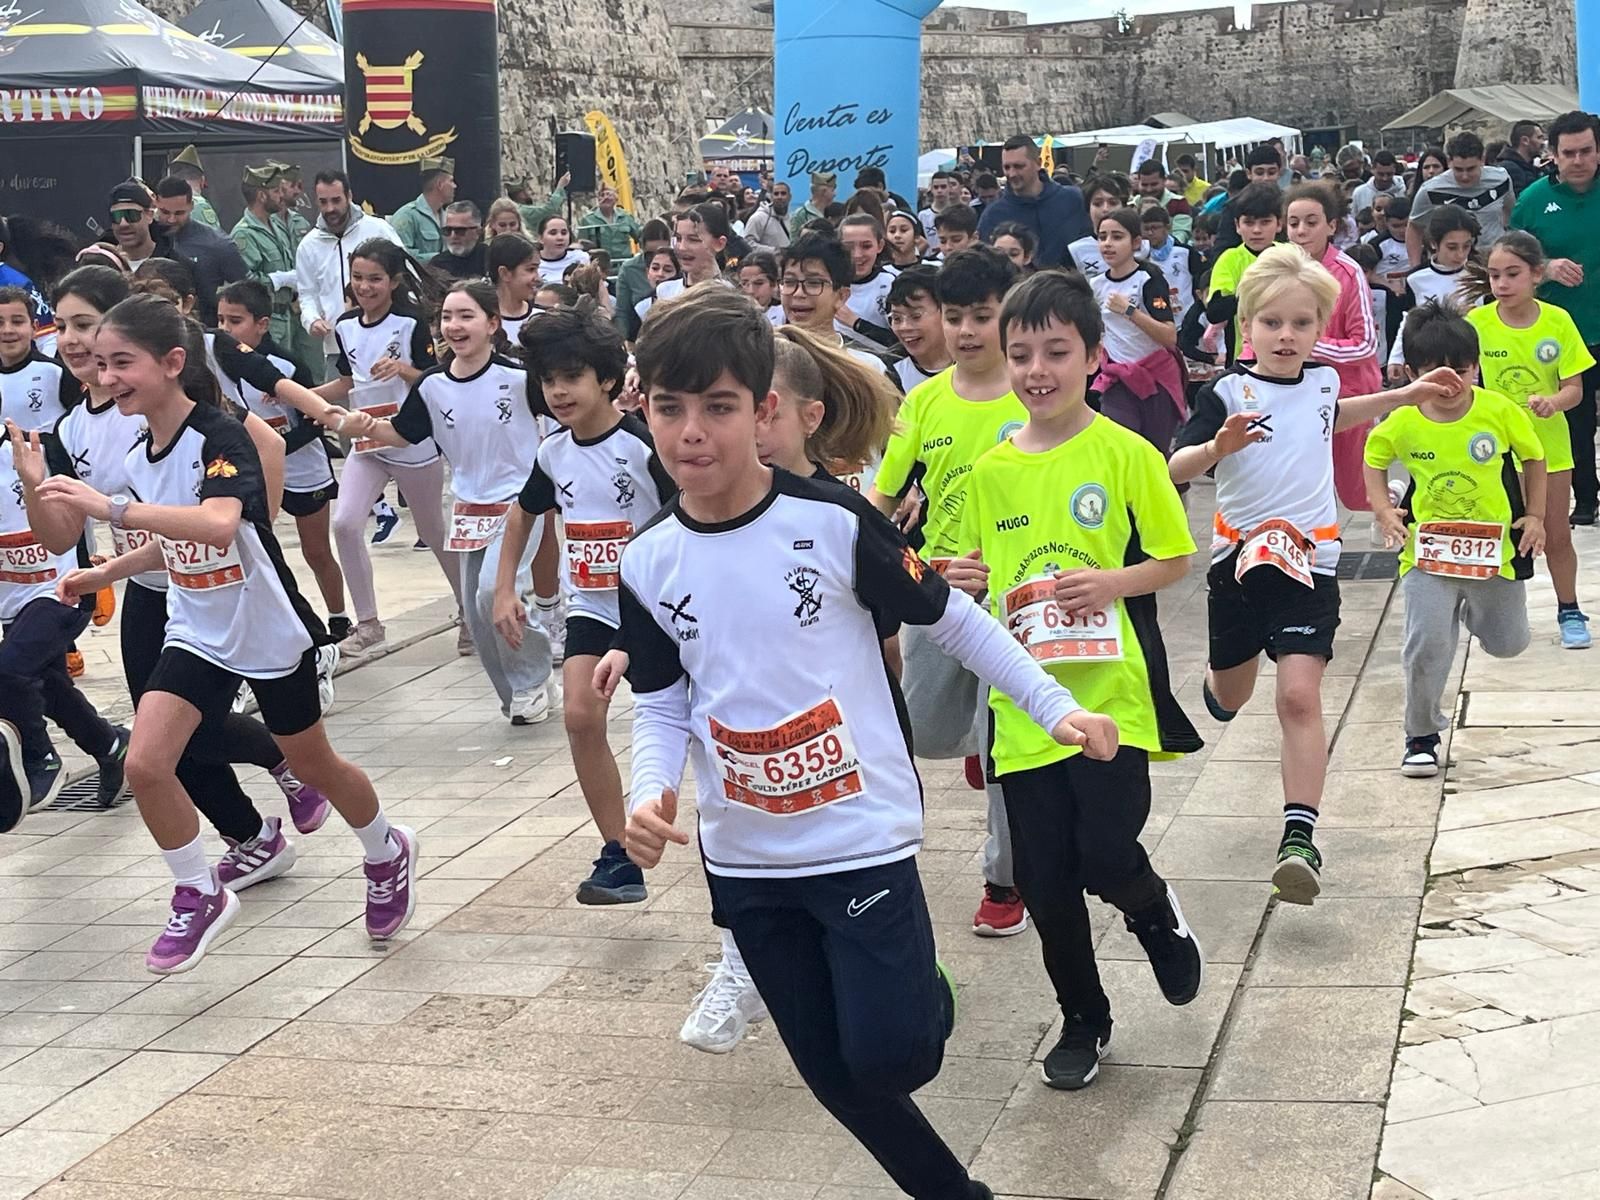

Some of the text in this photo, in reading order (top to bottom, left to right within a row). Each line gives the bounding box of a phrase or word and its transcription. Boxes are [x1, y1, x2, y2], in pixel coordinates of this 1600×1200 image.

[142, 86, 207, 119] TERCIO
[866, 108, 894, 125] es
[786, 144, 894, 178] Deporte
[923, 436, 953, 452] HUGO
[996, 514, 1029, 532] HUGO
[126, 531, 153, 550] 62
[1451, 538, 1495, 558] 6312
[6, 545, 48, 566] 6289
[1008, 541, 1103, 587] osAbrazosNoFractura
[1012, 625, 1035, 646] NF
[763, 734, 843, 785] 6359
[816, 759, 860, 782] CAZORLA
